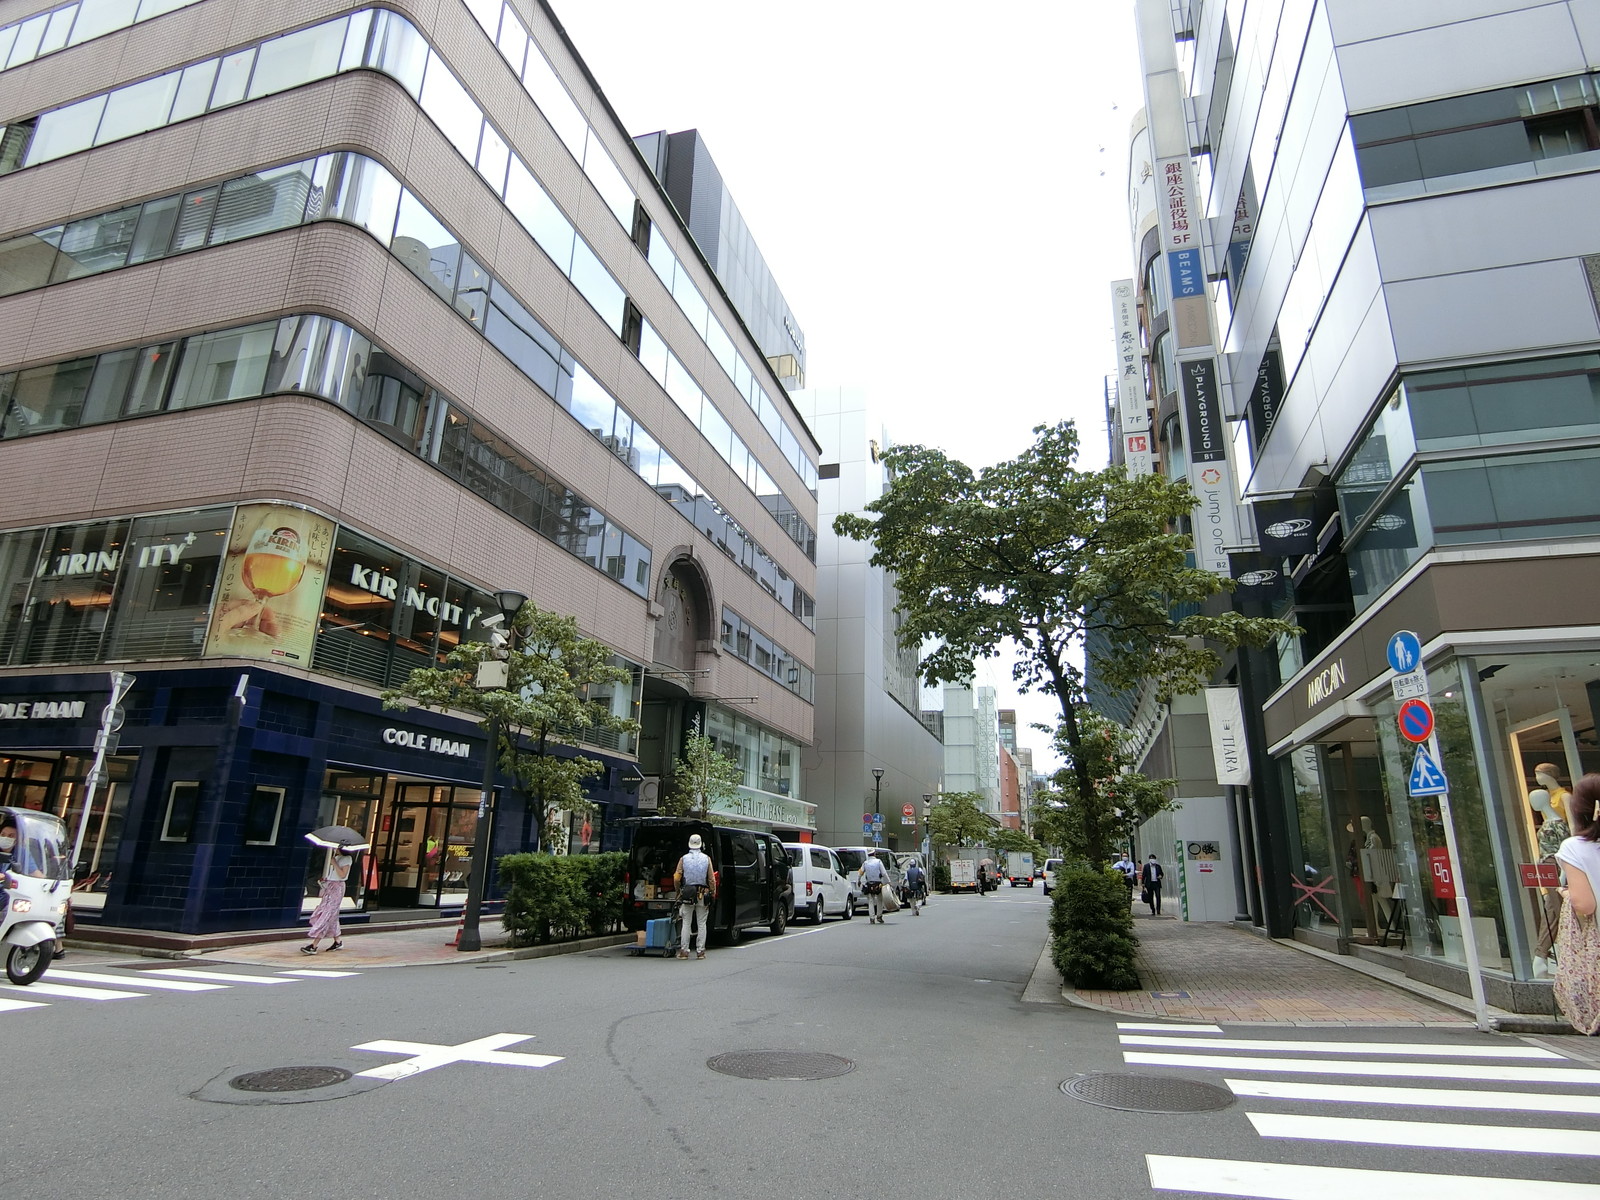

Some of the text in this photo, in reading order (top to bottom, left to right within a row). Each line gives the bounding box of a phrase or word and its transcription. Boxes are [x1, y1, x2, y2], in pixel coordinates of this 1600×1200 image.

[1165, 162, 1188, 231] 銀座公証役場
[1173, 234, 1191, 244] 5F
[1178, 252, 1194, 294] BEAMS
[1128, 415, 1142, 424] 7F
[1195, 376, 1211, 449] PLAYGROUND
[1204, 489, 1225, 555] jump one
[309, 523, 322, 558] 美味しい
[350, 563, 425, 611] KIRN
[30, 701, 86, 719] HAAN
[383, 728, 471, 758] COLE HAAN
[1222, 736, 1239, 773] TIARA
[736, 798, 769, 819] BEAUTY
